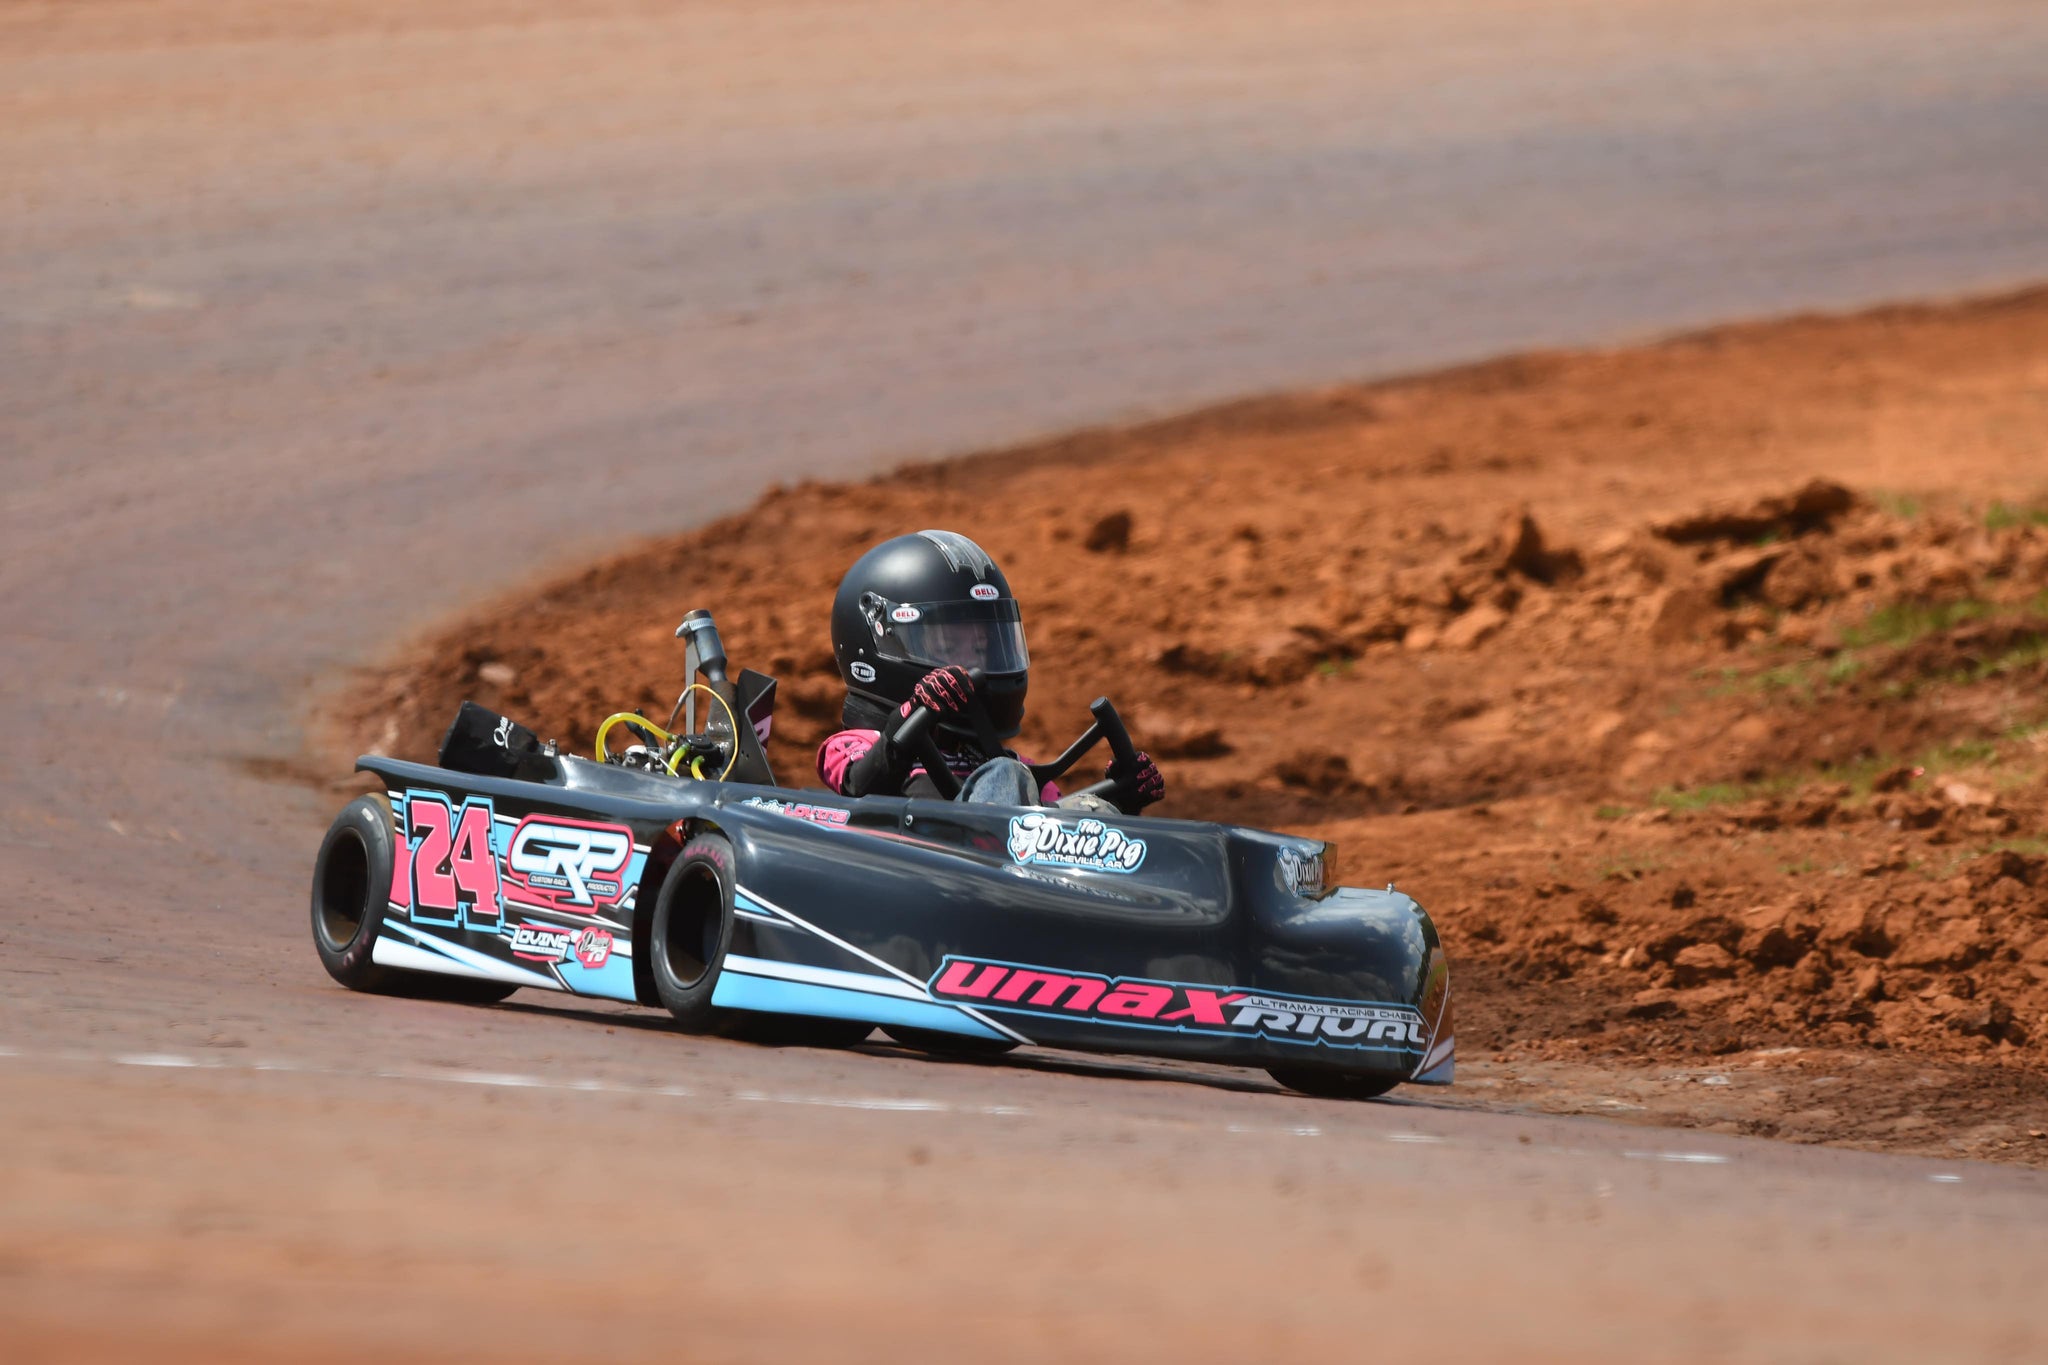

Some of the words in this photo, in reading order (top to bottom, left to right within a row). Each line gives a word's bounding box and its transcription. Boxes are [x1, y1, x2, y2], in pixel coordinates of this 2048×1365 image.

[975, 588, 996, 596] BELL
[1036, 822, 1099, 856] Dixie
[1098, 831, 1141, 867] Pig
[410, 799, 500, 915] 24
[1105, 860, 1123, 868] AR
[530, 875, 553, 884] CUSTOM
[587, 883, 616, 892] PRODUCTS
[1250, 997, 1325, 1014] ULTRAMAX
[1329, 1006, 1376, 1018] RACING
[1231, 1006, 1425, 1043] RIVAL
